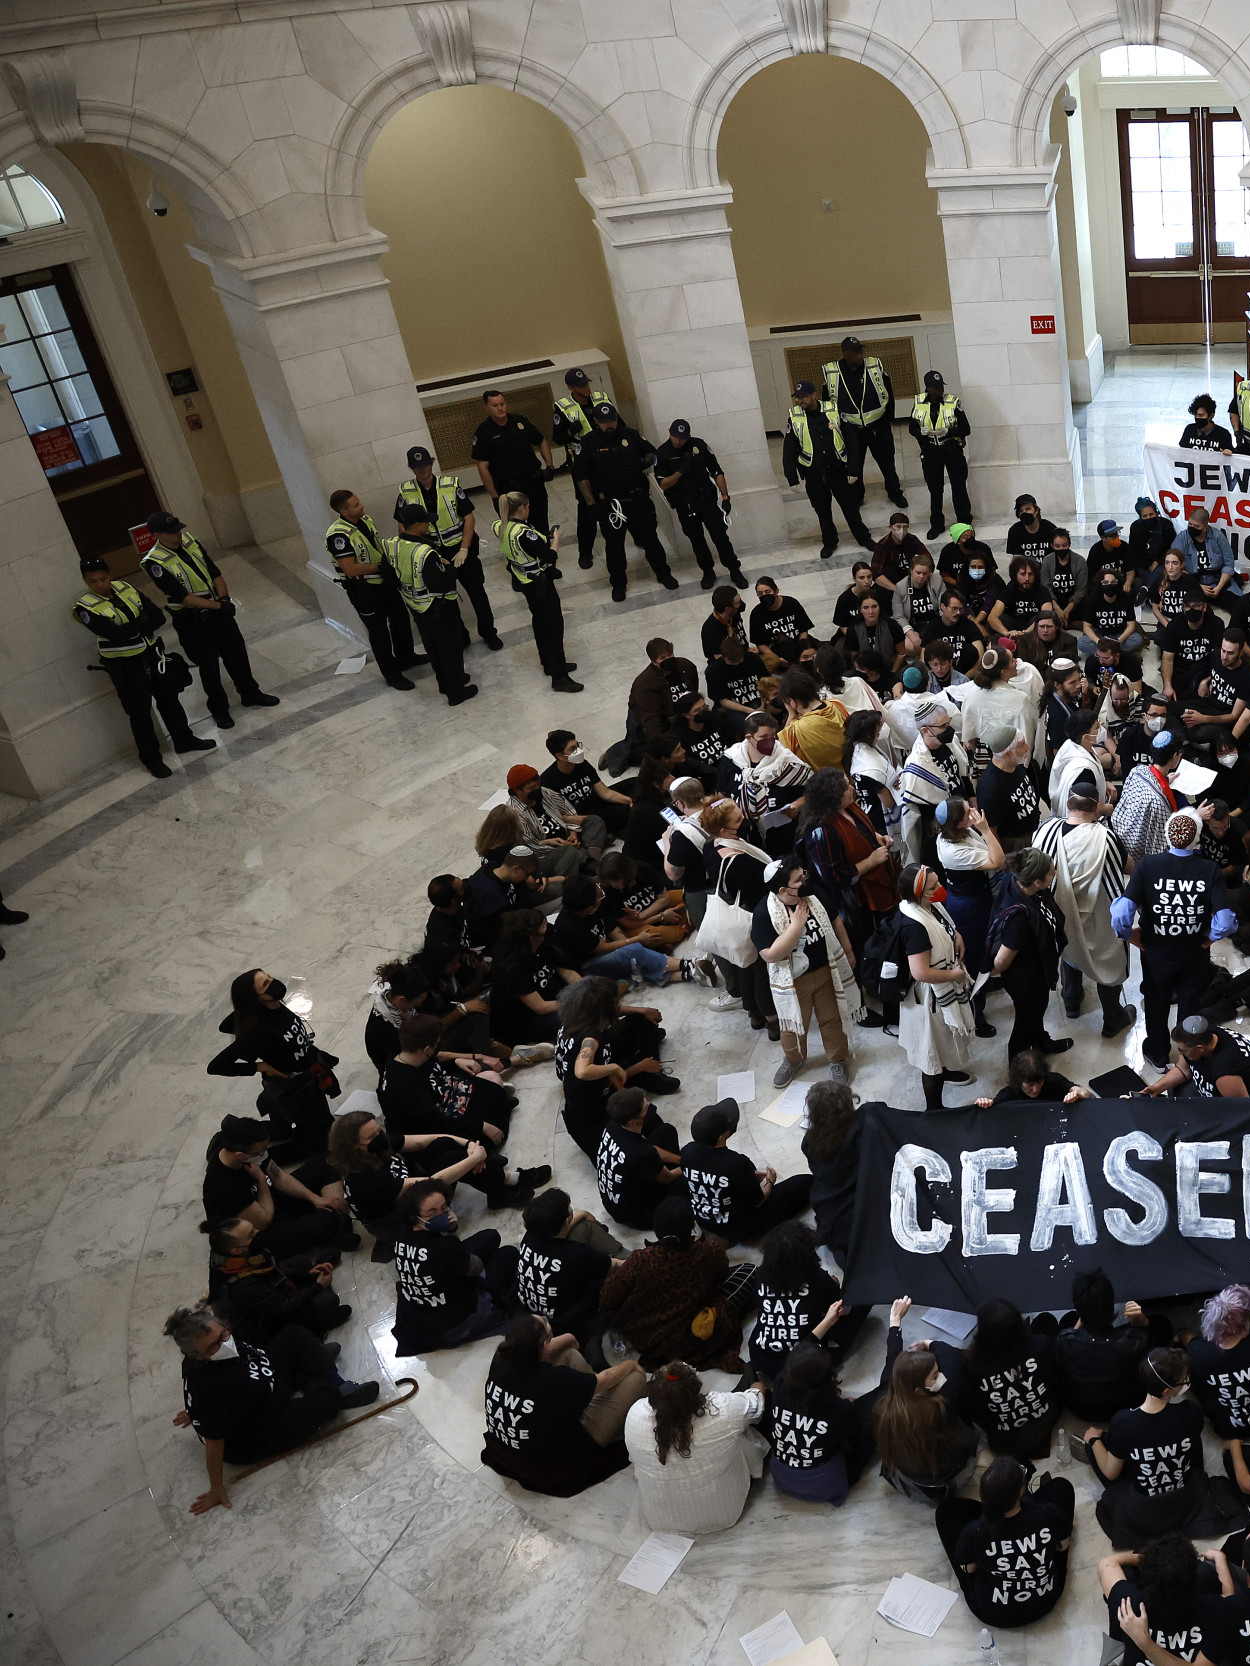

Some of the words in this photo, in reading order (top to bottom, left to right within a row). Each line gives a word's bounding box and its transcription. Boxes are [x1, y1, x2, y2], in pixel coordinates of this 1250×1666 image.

[1032, 320, 1053, 329] EXIT
[764, 618, 785, 630] NOT
[786, 615, 796, 624] IN
[728, 679, 745, 689] NOT
[748, 675, 758, 683] IN
[734, 684, 757, 697] OUR
[1212, 679, 1229, 697] OUR
[1226, 685, 1236, 694] IN
[691, 737, 710, 752] NOT
[711, 732, 721, 742] IN
[560, 782, 577, 795] NOT
[581, 775, 591, 785] IN
[1010, 782, 1024, 802] NOT
[1154, 878, 1206, 892] JEWS
[1152, 904, 1205, 915] CEASE
[1159, 893, 1198, 906] SAY
[1153, 922, 1202, 936] NOW
[1160, 915, 1197, 925] FIRE
[683, 1168, 729, 1188] JEWS
[688, 1181, 722, 1199] SAY
[396, 1259, 421, 1276] SAY
[519, 1243, 562, 1272] JEWS
[401, 1271, 435, 1286] EASE
[517, 1259, 551, 1285] SAY
[763, 1299, 801, 1314] SAY
[760, 1313, 809, 1326] CEASE
[764, 1327, 800, 1340] FIRE
[980, 1358, 1038, 1393] JEWS
[486, 1381, 535, 1414] JEWS
[989, 1376, 1033, 1404] SAY
[486, 1399, 522, 1427] SAY
[771, 1406, 829, 1435] JEWS
[997, 1402, 1050, 1432] NOW
[774, 1422, 817, 1450] SAY
[1130, 1437, 1192, 1461] JEWS
[1139, 1455, 1186, 1476] SAY
[985, 1527, 1052, 1557] JEWS
[997, 1547, 1048, 1572] SAY
[992, 1580, 1055, 1605] NOW
